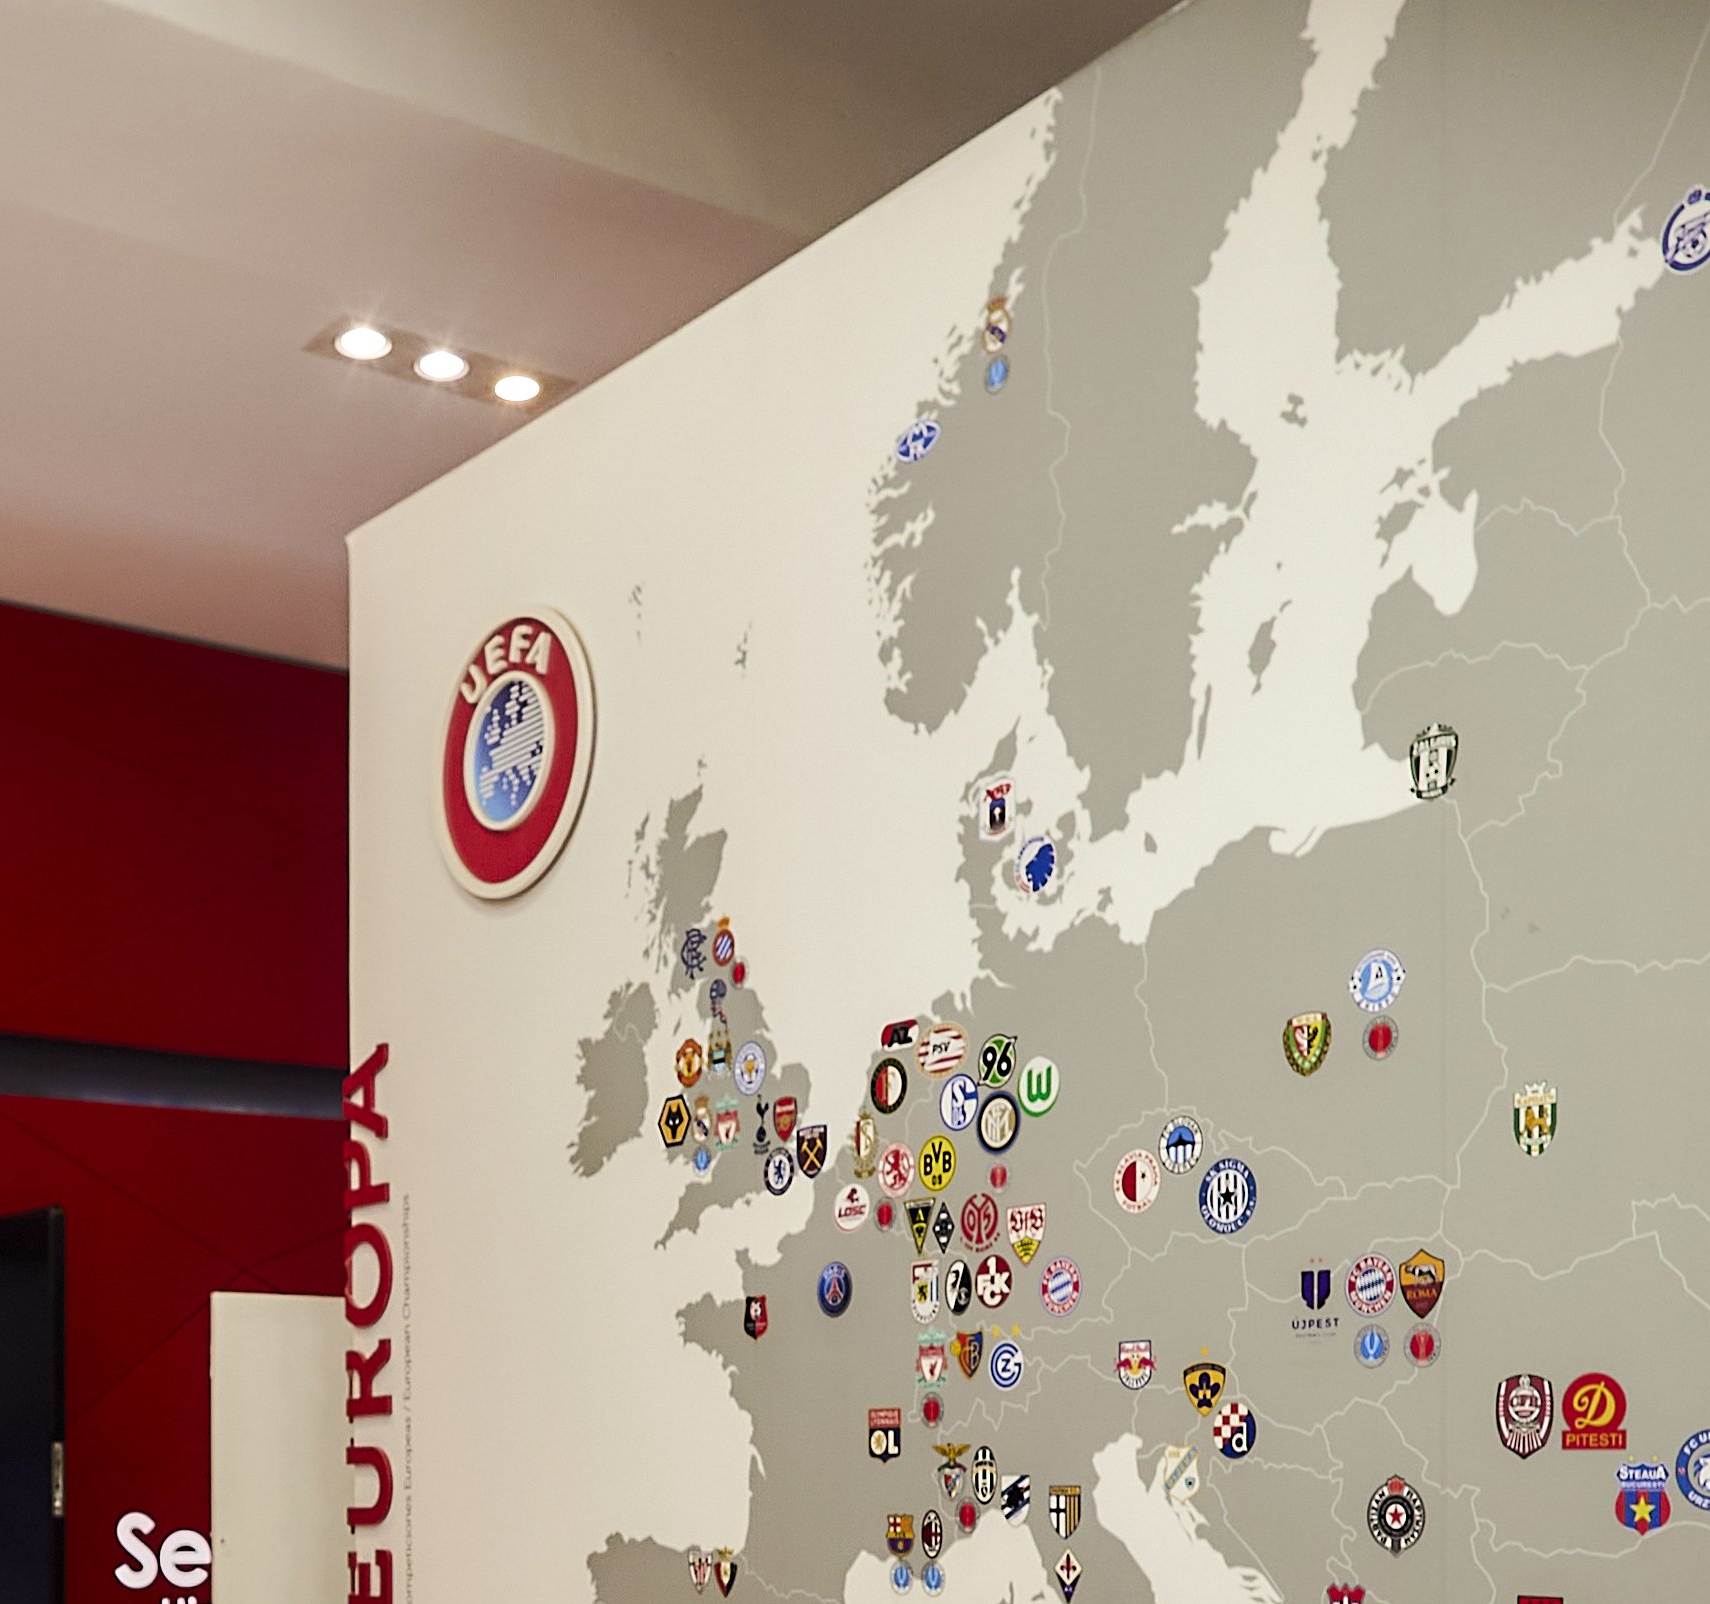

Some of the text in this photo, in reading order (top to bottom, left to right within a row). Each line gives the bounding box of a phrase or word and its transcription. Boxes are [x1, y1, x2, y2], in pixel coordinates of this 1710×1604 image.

[460, 624, 553, 704] UEFA
[402, 1193, 411, 1320] Championships
[403, 1324, 413, 1403] European
[403, 1417, 413, 1491] Europeas
[1565, 1433, 1623, 1447] PITESTI
[114, 1511, 212, 1589] Se
